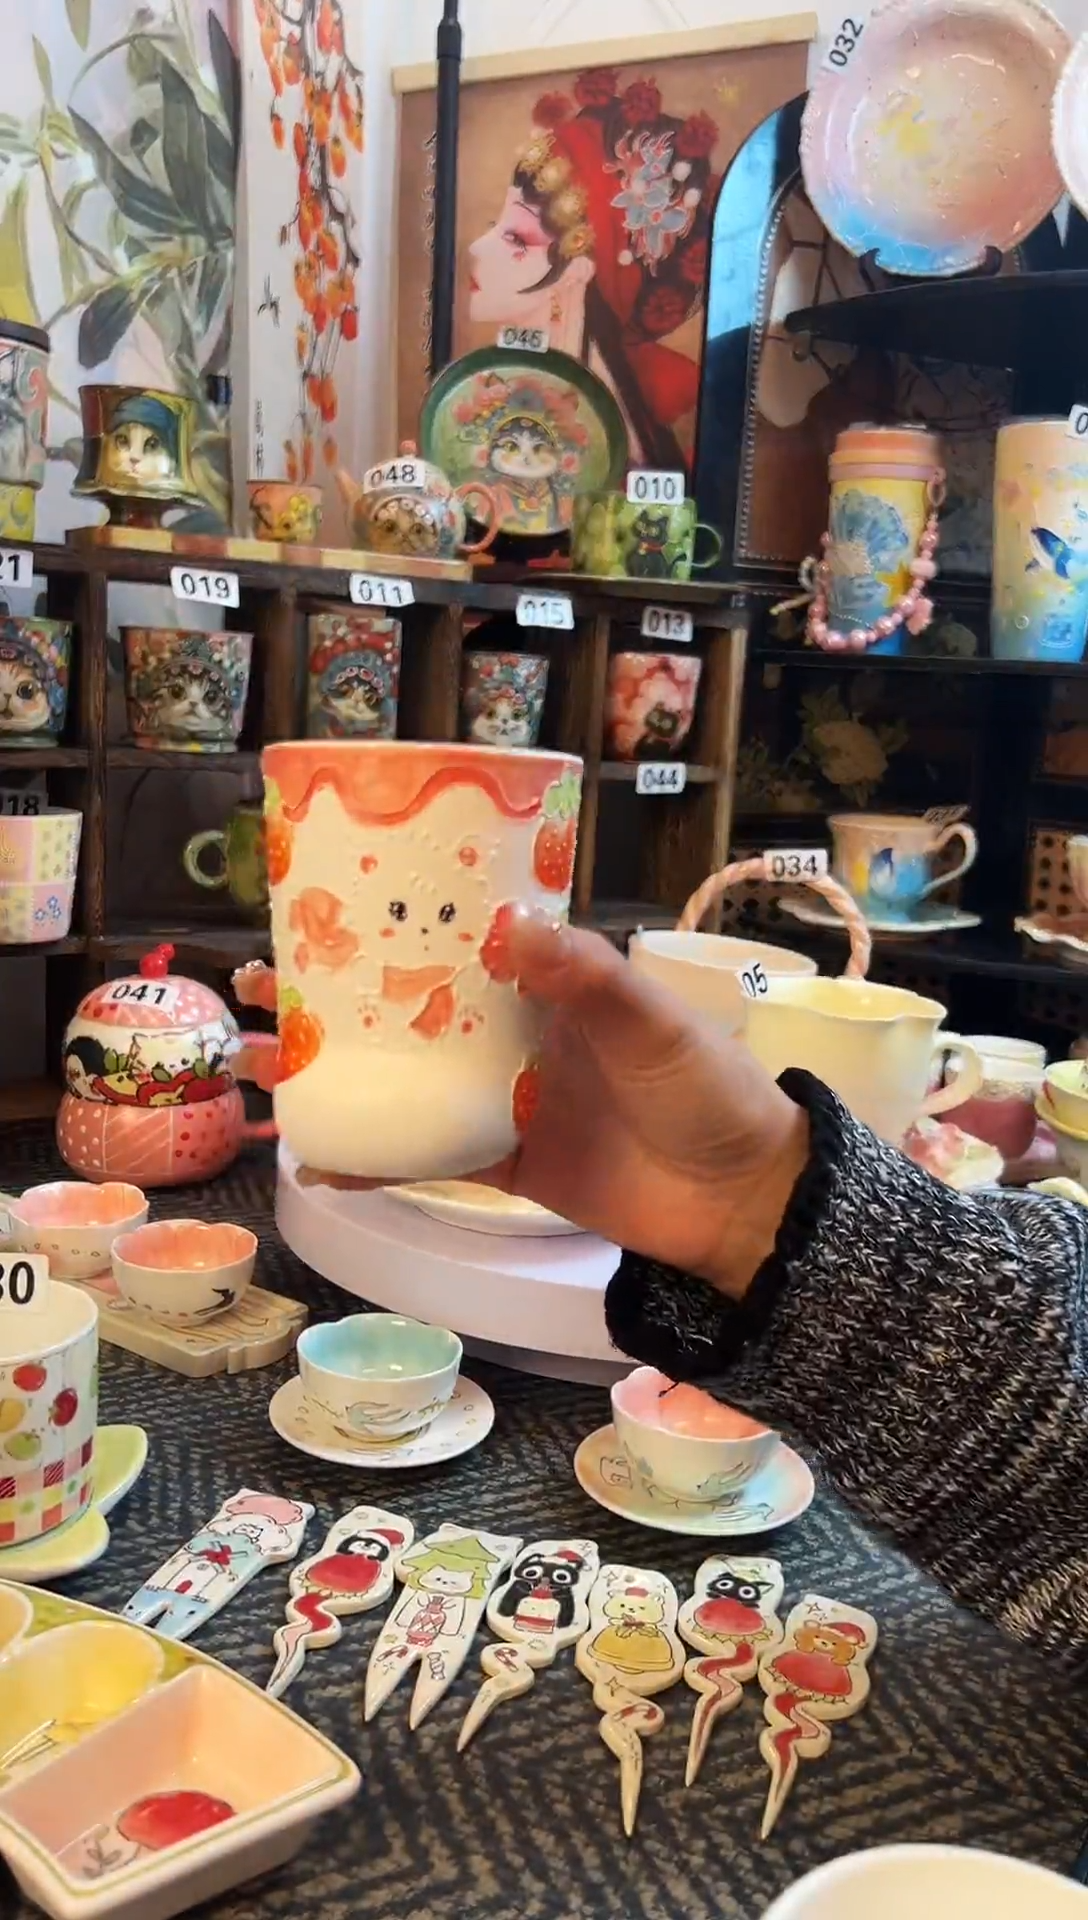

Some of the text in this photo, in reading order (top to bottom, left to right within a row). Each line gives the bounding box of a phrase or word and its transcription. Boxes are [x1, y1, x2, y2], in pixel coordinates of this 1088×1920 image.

[828, 18, 864, 67] 032
[371, 464, 415, 488] 048
[634, 476, 676, 500] 010
[0, 554, 20, 581] 1
[180, 572, 230, 599] 019
[357, 579, 402, 604] 011
[523, 600, 564, 625] 015
[648, 610, 685, 636] 013
[642, 768, 678, 789] 044
[771, 854, 818, 878] 034
[111, 983, 167, 1005] 041
[0, 1261, 35, 1305] 0
